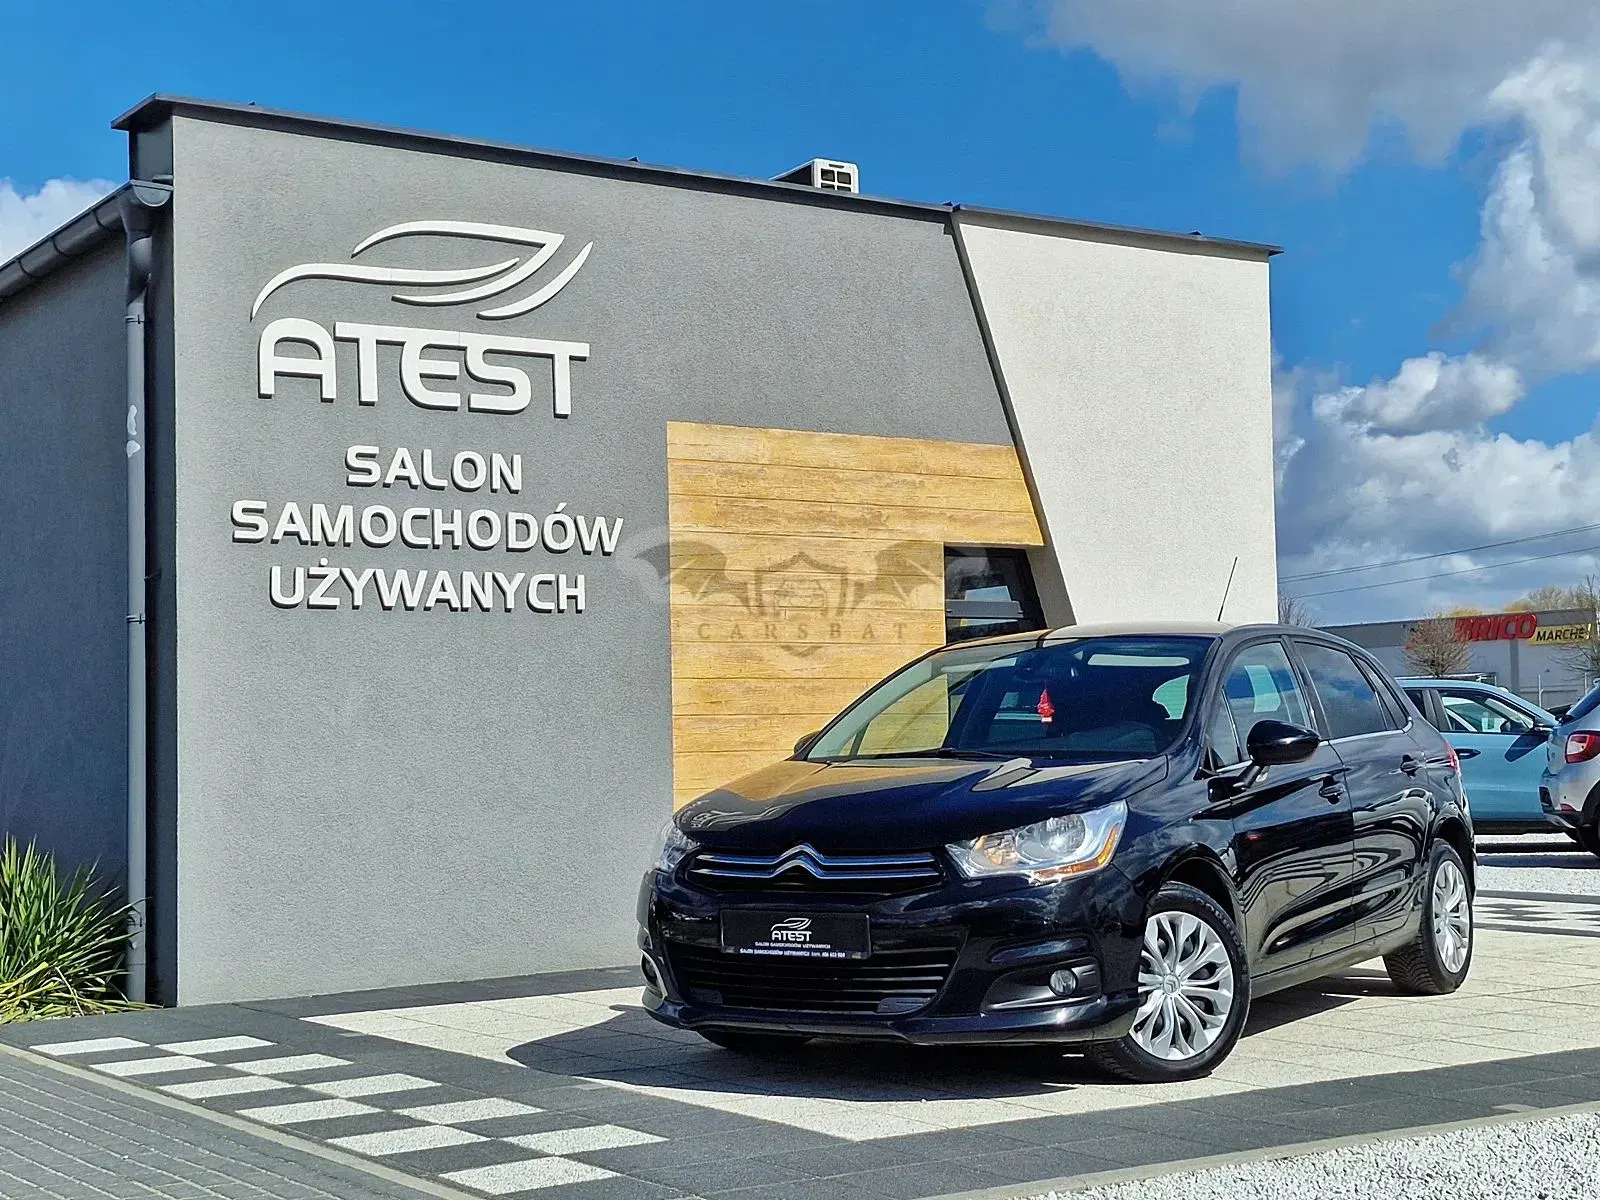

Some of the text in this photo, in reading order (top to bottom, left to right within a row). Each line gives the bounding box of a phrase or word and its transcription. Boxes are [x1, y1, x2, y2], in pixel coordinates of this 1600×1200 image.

[258, 317, 589, 418] ATEST
[345, 445, 522, 494] SALON
[231, 500, 624, 556] SAMOCHODÓW
[269, 557, 586, 613] UŻYWANYCH
[772, 930, 812, 941] ATEST
